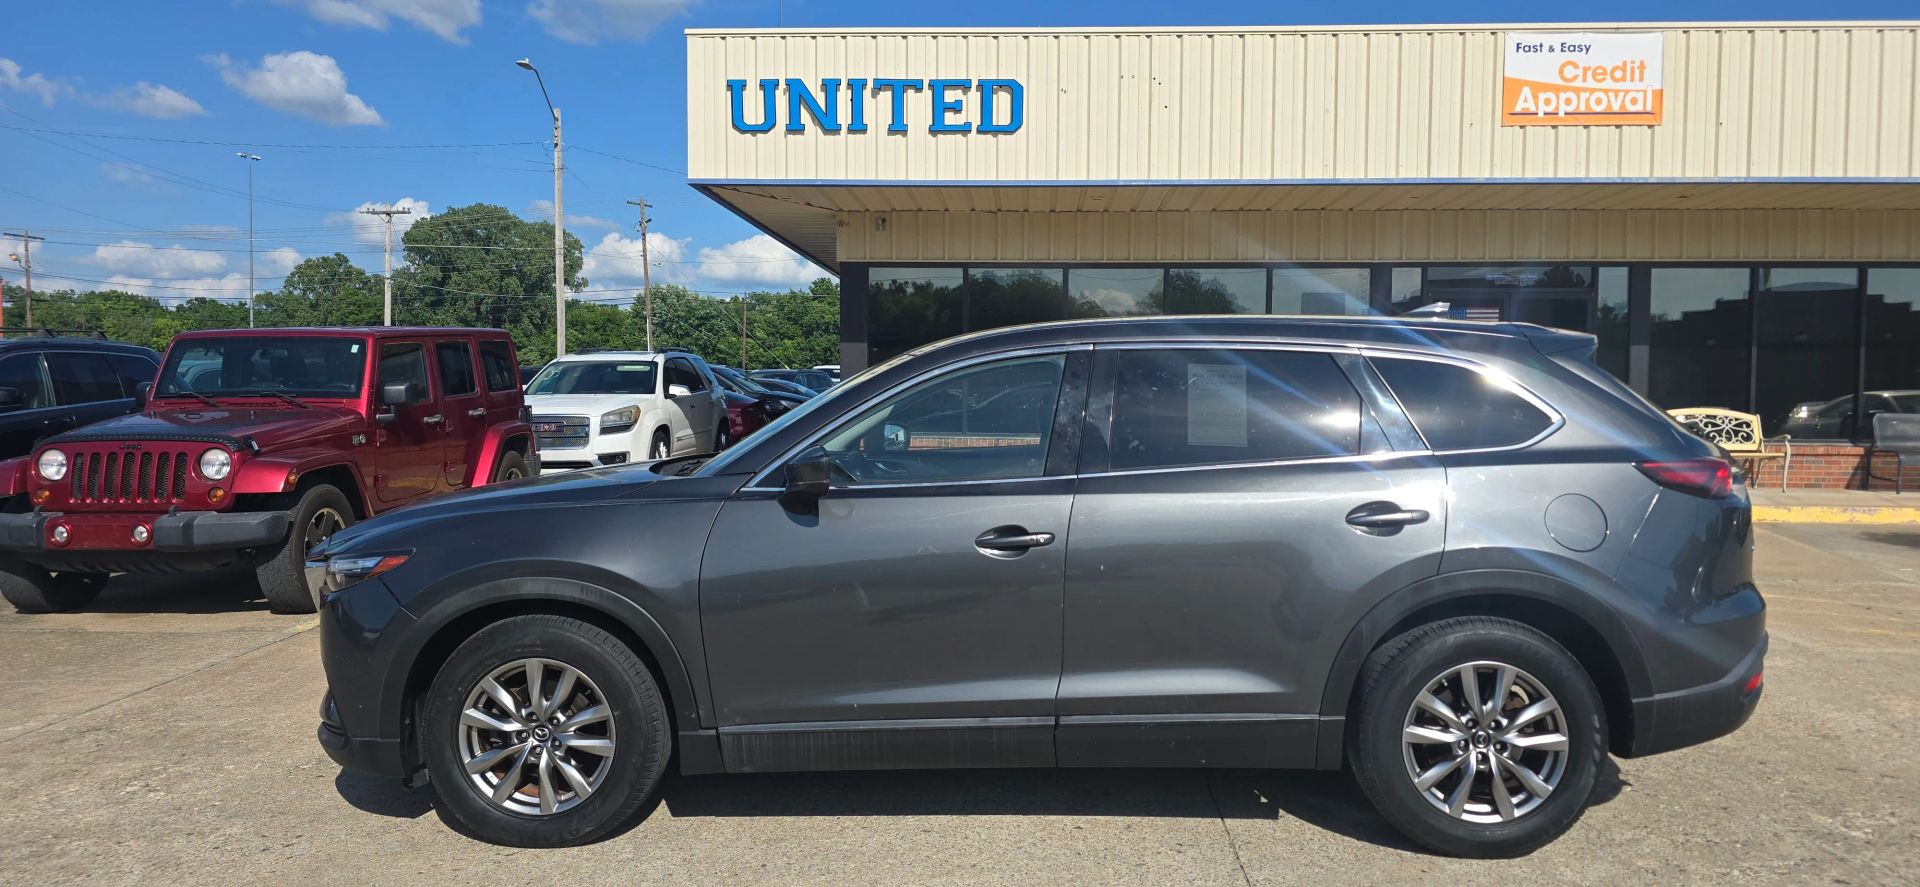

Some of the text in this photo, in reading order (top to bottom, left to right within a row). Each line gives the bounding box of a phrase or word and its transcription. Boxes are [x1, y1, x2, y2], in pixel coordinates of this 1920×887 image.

[1516, 42, 1592, 55] Fast & Easy
[1558, 60, 1647, 83] Credit
[726, 78, 1024, 133] UNITED
[1514, 85, 1654, 118] Approval
